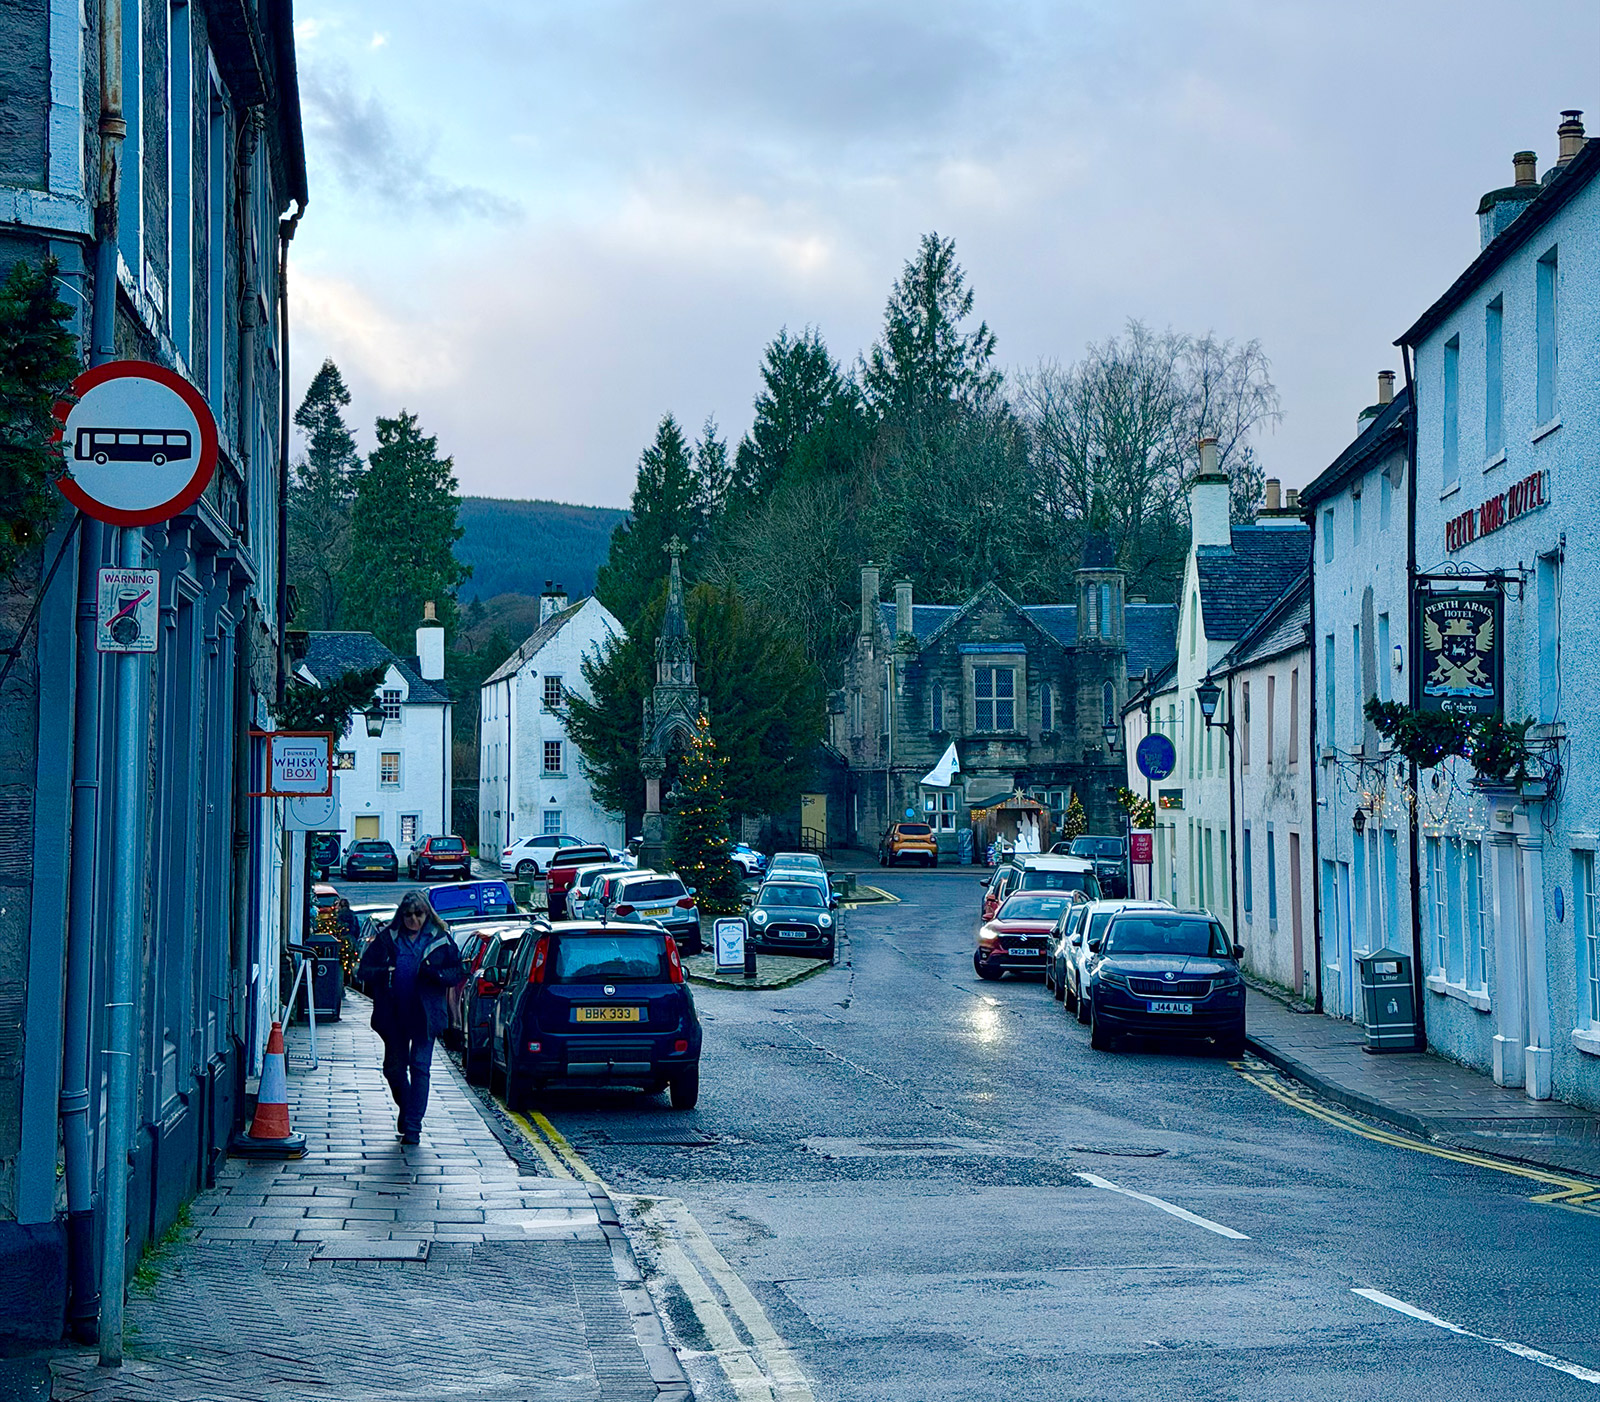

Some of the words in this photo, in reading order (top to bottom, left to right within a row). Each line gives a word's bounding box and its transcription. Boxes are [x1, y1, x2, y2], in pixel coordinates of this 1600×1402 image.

[1446, 508, 1474, 552] PERTH
[1480, 493, 1505, 537] ARMS
[1509, 470, 1544, 520] HOTEL
[104, 574, 154, 584] WARNING
[1425, 600, 1459, 615] PERTH
[1463, 601, 1494, 617] ARMS
[1444, 610, 1474, 618] HOTEL
[274, 758, 326, 767] WHISKY
[286, 768, 313, 778] BOX
[1154, 1003, 1171, 1011] J44
[1172, 1003, 1189, 1012] ALC
[585, 1009, 607, 1019] BBK
[610, 1009, 631, 1019] 333
